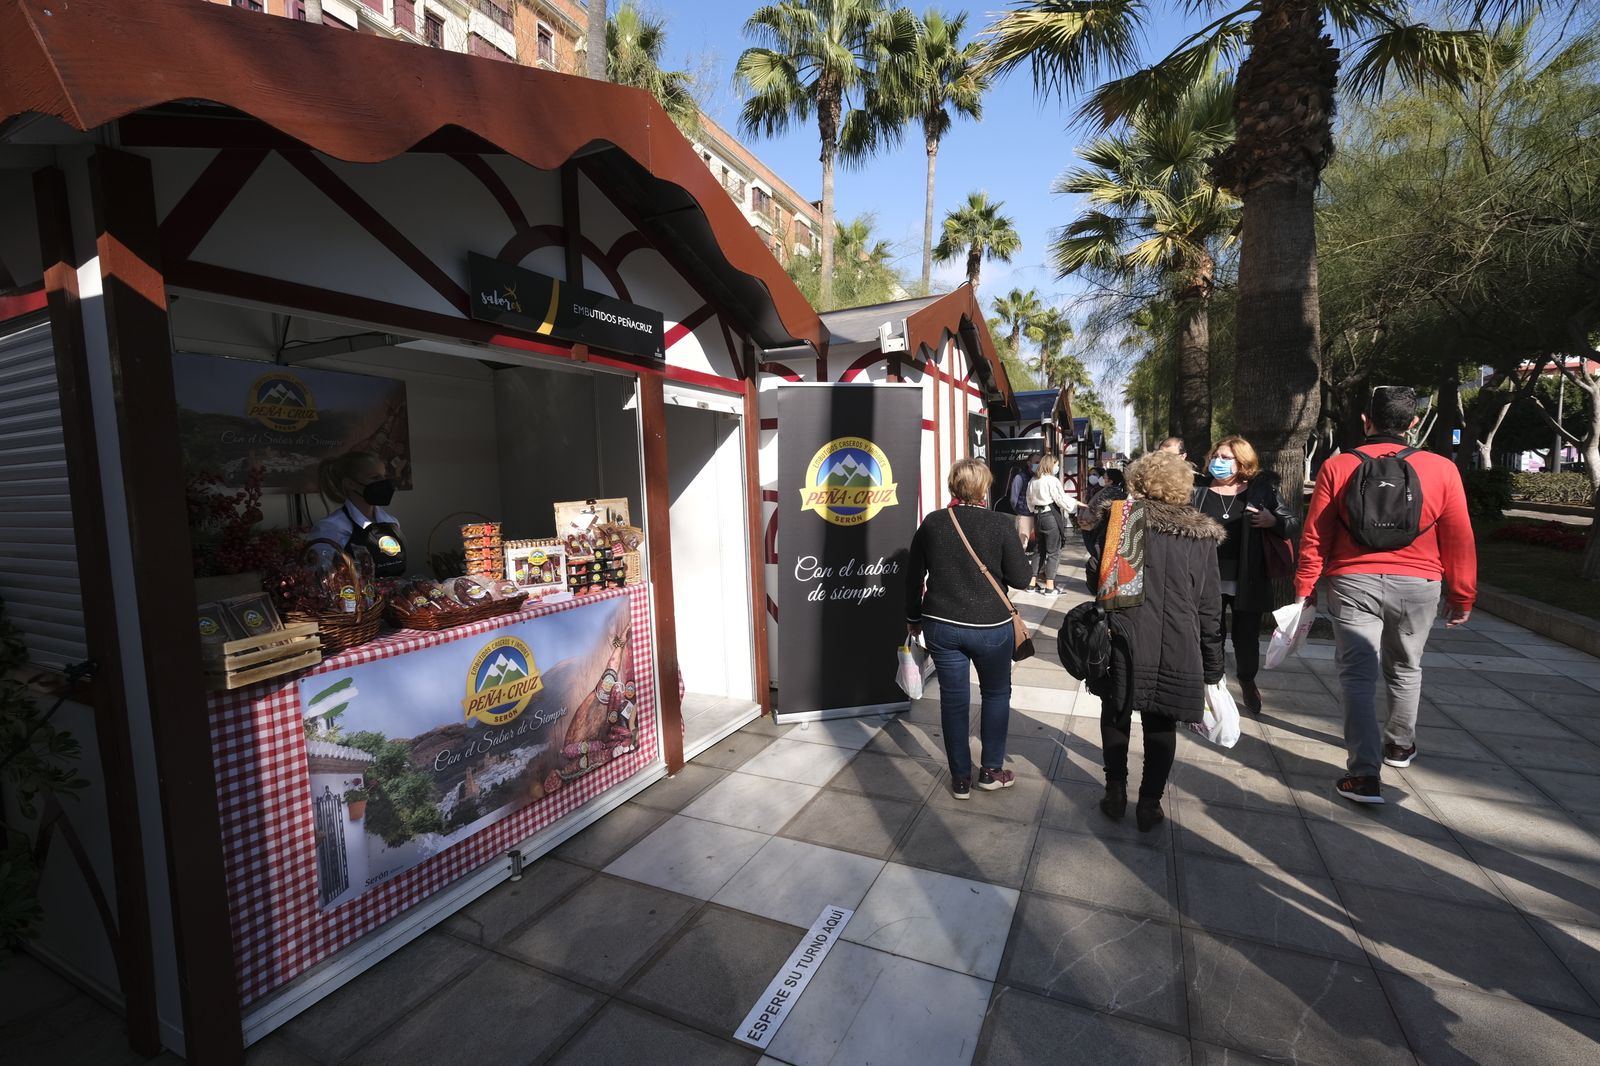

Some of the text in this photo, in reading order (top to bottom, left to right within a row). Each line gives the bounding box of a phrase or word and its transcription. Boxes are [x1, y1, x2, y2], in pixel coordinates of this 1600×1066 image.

[573, 303, 653, 334] EMBUTIDOS PEÑACRUZ
[287, 408, 315, 419] CRUZ
[838, 440, 863, 449] CASEROS
[806, 488, 894, 506] PEÑA CRUZ
[835, 514, 863, 523] SERÓN
[794, 555, 900, 582] Con el sabor
[807, 582, 886, 606] de siempre
[467, 675, 539, 716] PEÑA CRUZ
[434, 706, 568, 772] Con el Sabor de Siempre
[746, 909, 845, 1041] ESPERE SU TURNO AQUÍ
